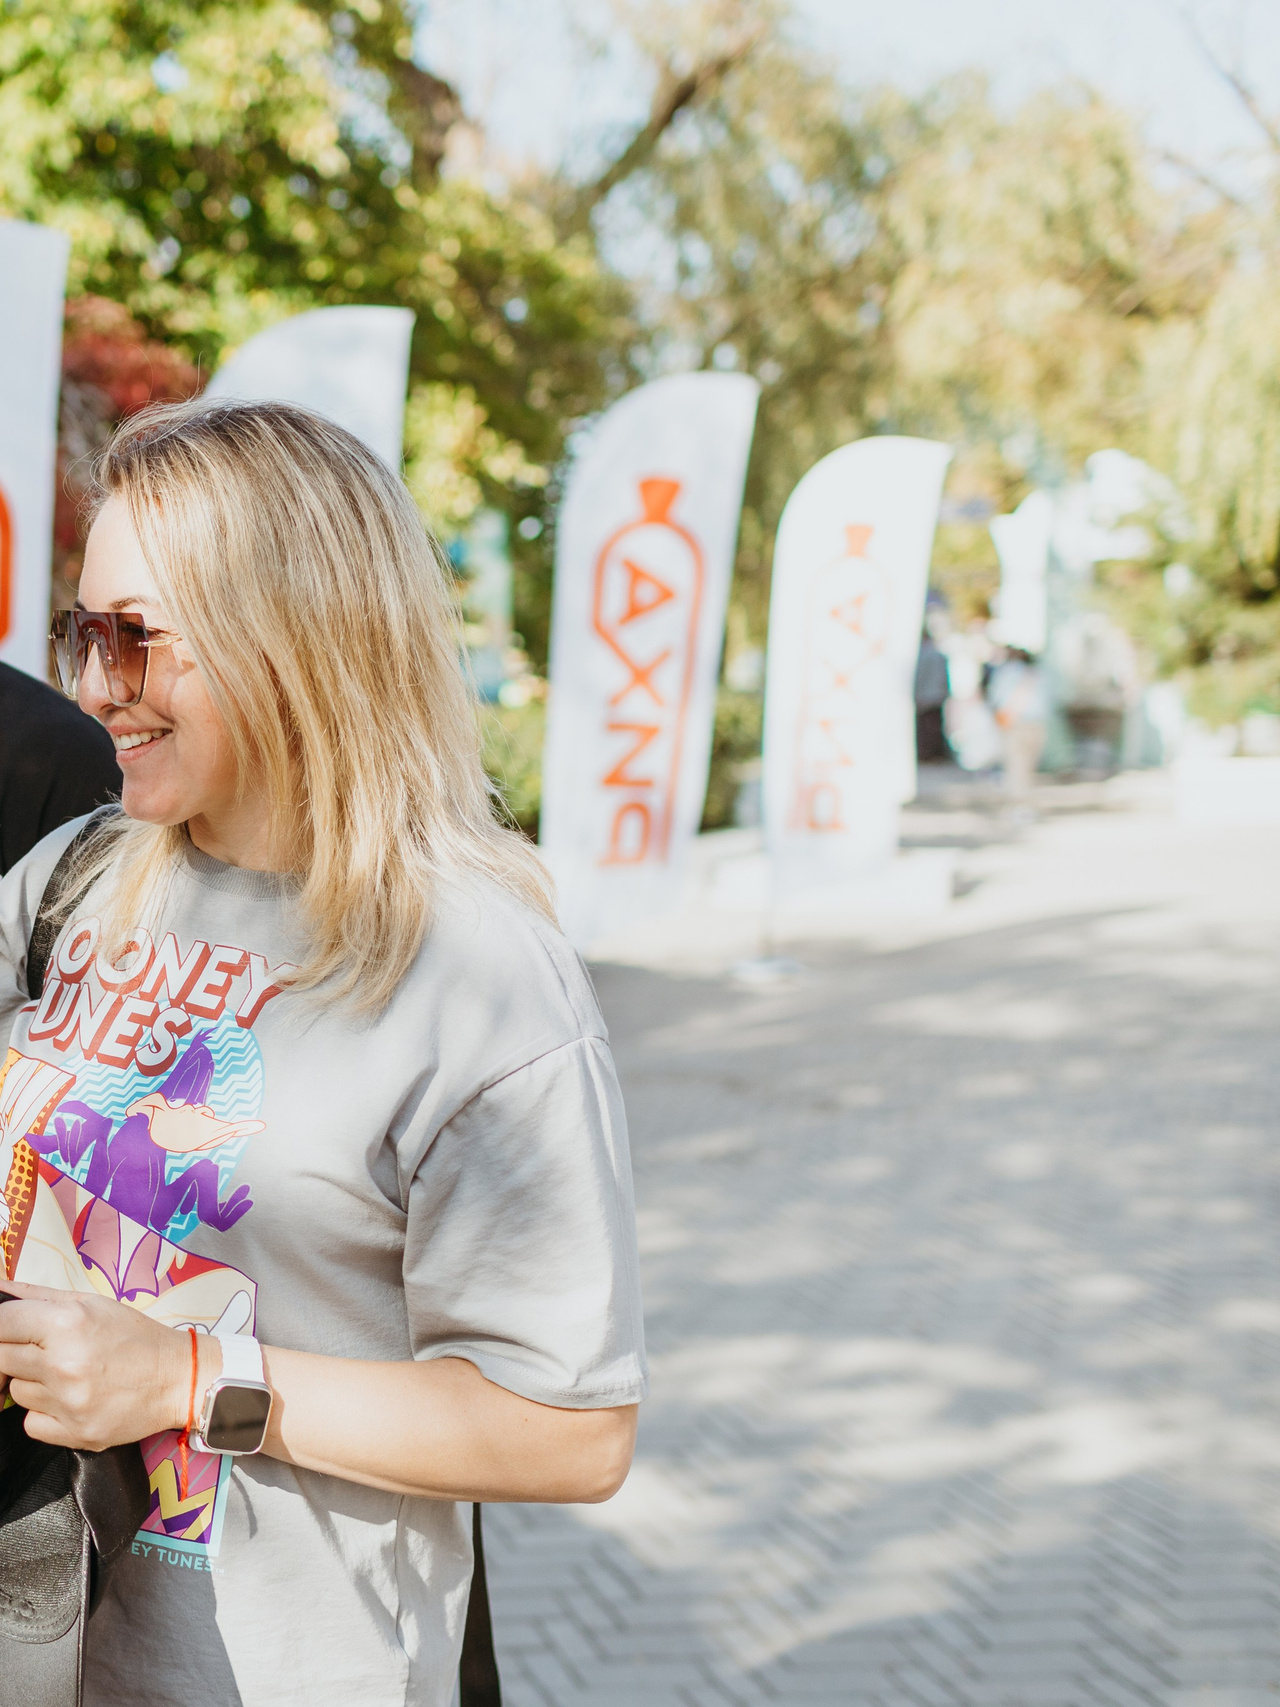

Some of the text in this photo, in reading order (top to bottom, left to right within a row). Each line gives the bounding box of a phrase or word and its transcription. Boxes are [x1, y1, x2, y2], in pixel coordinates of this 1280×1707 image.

[44, 915, 301, 1030] OONEY
[20, 977, 193, 1078] UNES
[131, 1541, 152, 1558] EY
[157, 1548, 215, 1573] TUNES
